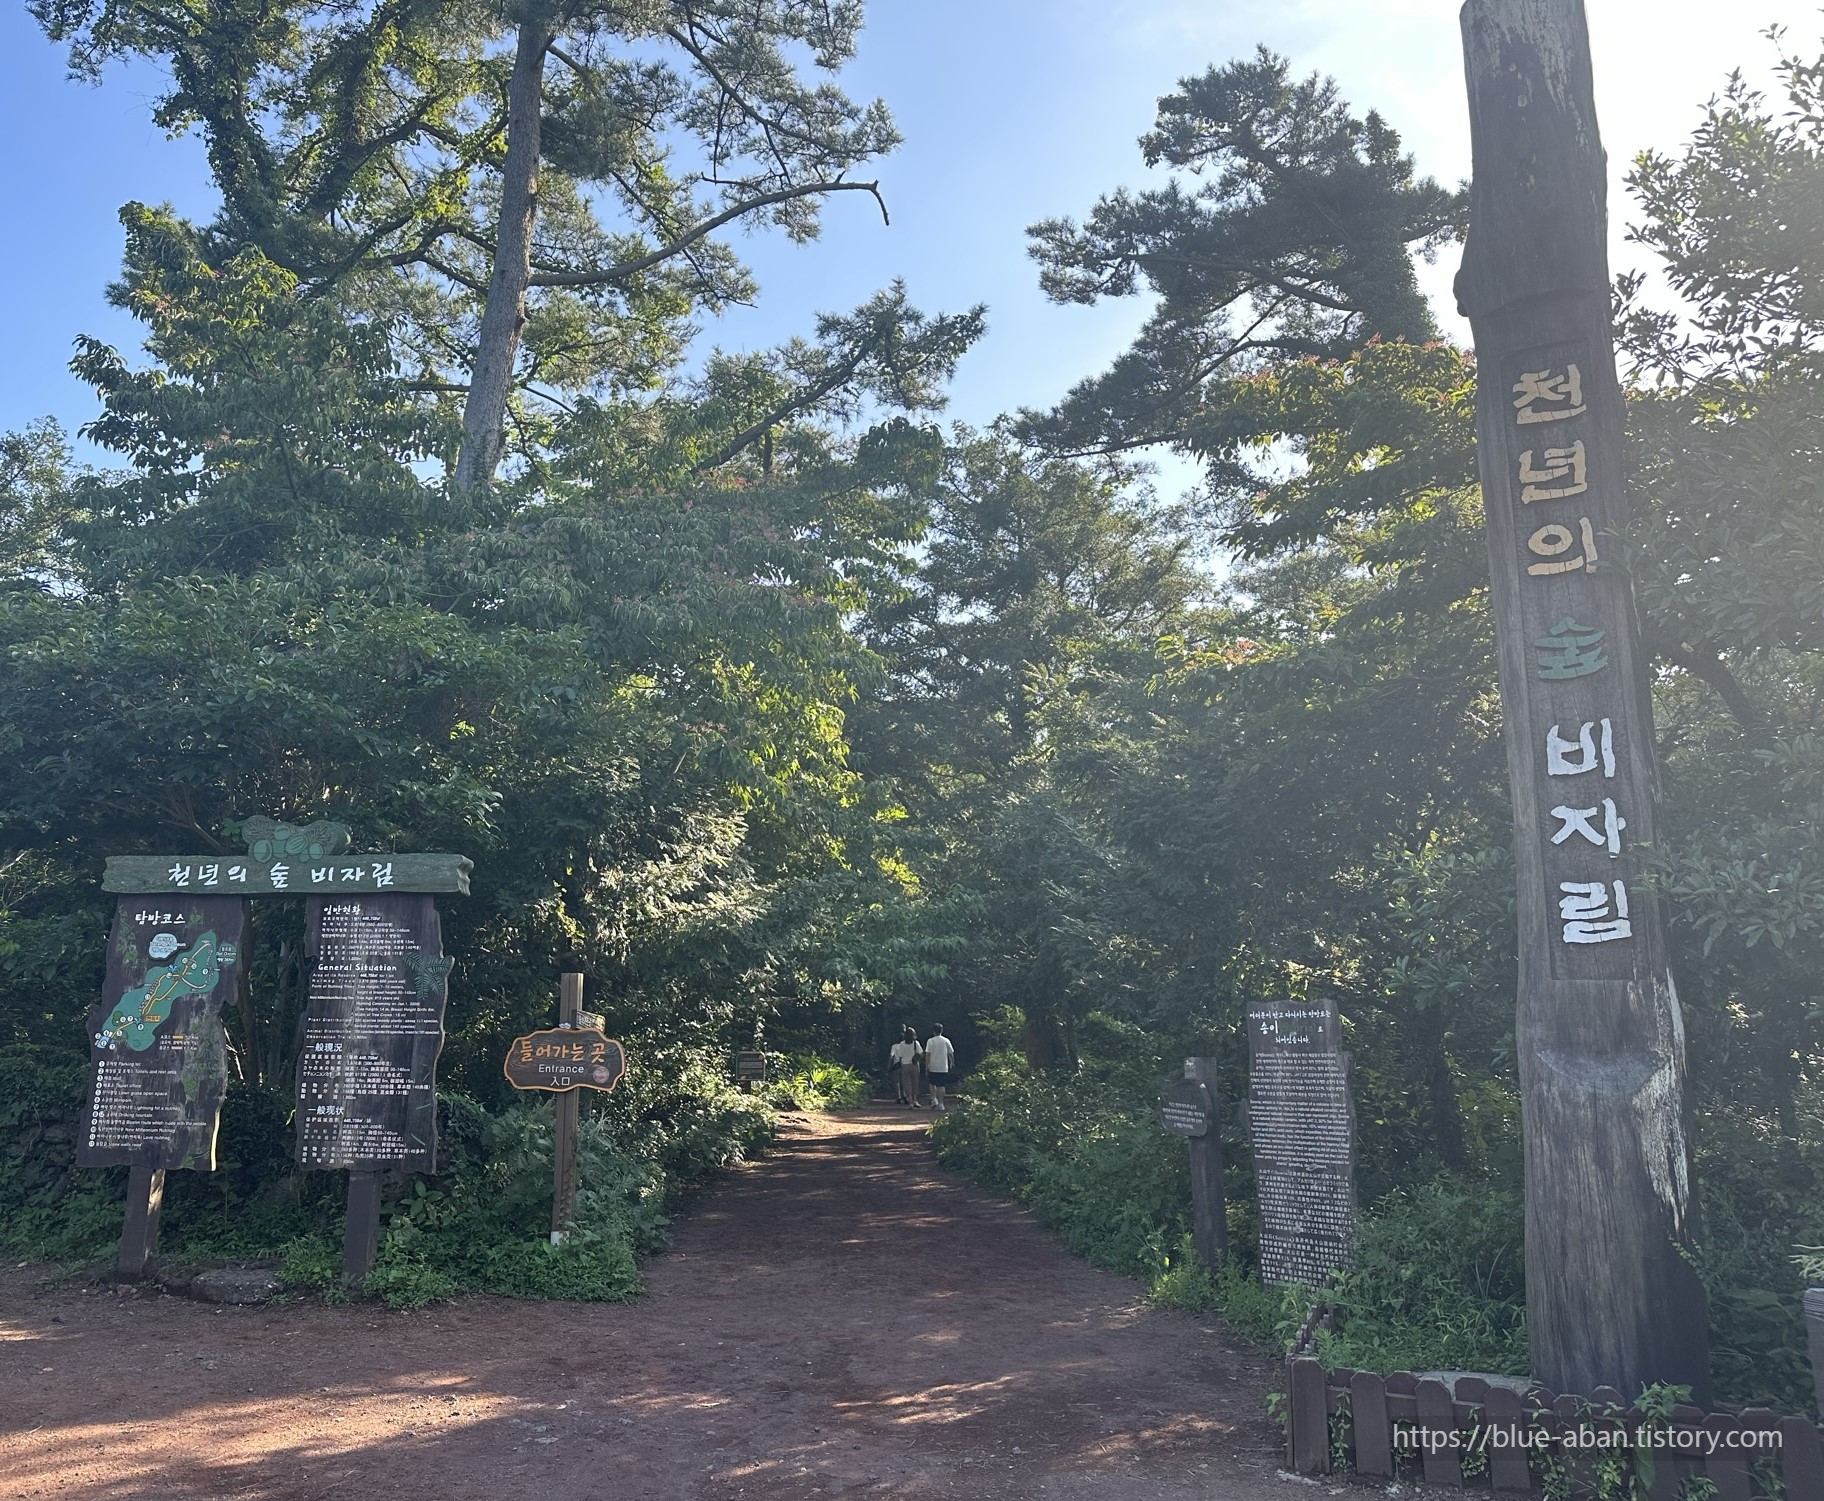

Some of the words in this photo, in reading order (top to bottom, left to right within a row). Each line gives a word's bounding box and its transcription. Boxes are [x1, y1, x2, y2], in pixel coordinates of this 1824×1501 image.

[1512, 363, 1598, 577] 천년의
[1534, 616, 1609, 681] 숲
[1546, 717, 1633, 945] 비자림
[168, 862, 247, 887] 천년의
[269, 861, 291, 889] 숲
[311, 862, 395, 888] 비자림
[135, 910, 186, 926] 탐방코스
[318, 963, 353, 971] General
[355, 963, 397, 972] Situation
[1260, 1020, 1279, 1035] 송이
[306, 1042, 343, 1053] 一般現況
[520, 1039, 584, 1063] 들어가는
[590, 1042, 606, 1064] 곳
[538, 1063, 585, 1074] Entrance
[550, 1076, 570, 1087] 入口
[308, 1105, 344, 1115] 一般现状
